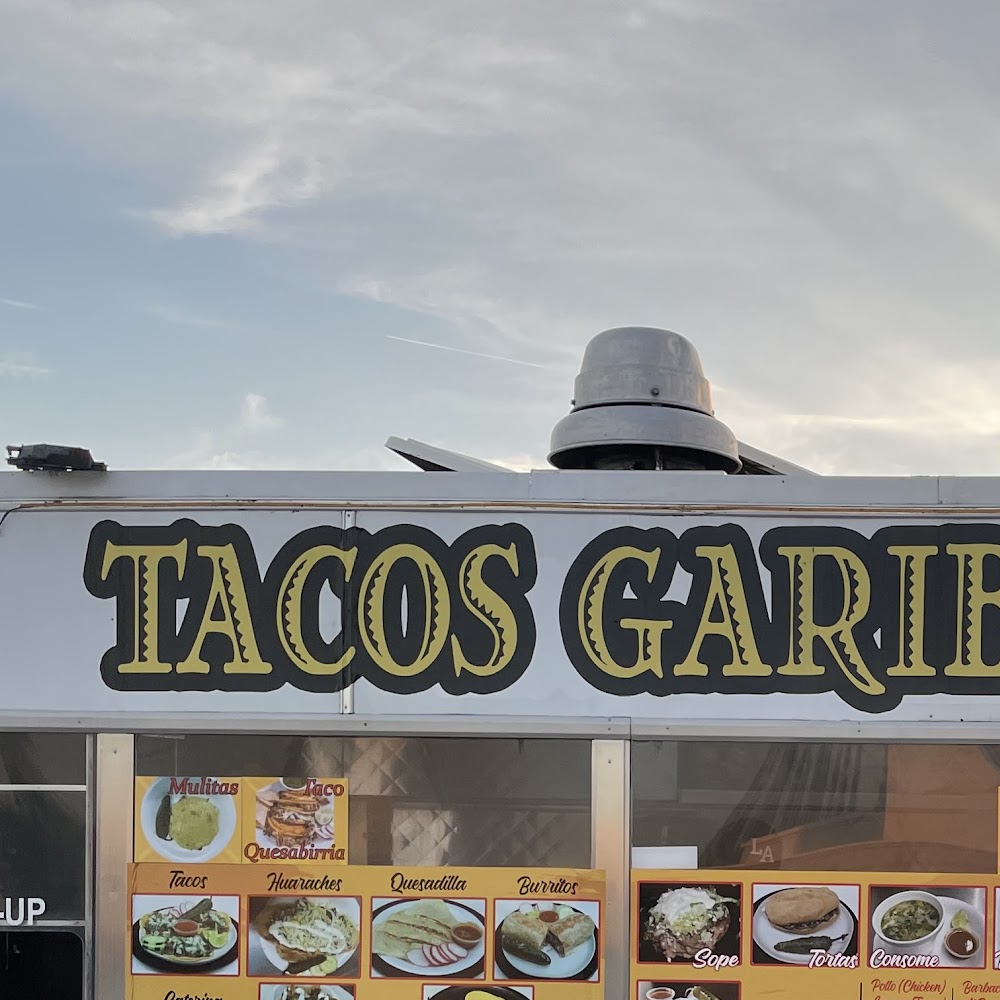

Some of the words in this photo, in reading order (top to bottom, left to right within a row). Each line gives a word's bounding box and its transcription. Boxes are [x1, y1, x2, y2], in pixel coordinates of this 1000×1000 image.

[99, 536, 521, 680] TACOS
[167, 777, 239, 796] Mulitas
[304, 778, 345, 796] Taco
[244, 842, 346, 863] Quesabirria
[169, 871, 208, 889] Tacos
[266, 872, 343, 892] Huaraches
[390, 872, 467, 893] Quesadilla
[517, 876, 579, 895] Burritos
[692, 948, 740, 971] Sope
[808, 948, 859, 969] Tortas
[869, 948, 940, 969] Consome
[870, 979, 897, 992] Pollo
[898, 979, 946, 995] (Chicken)
